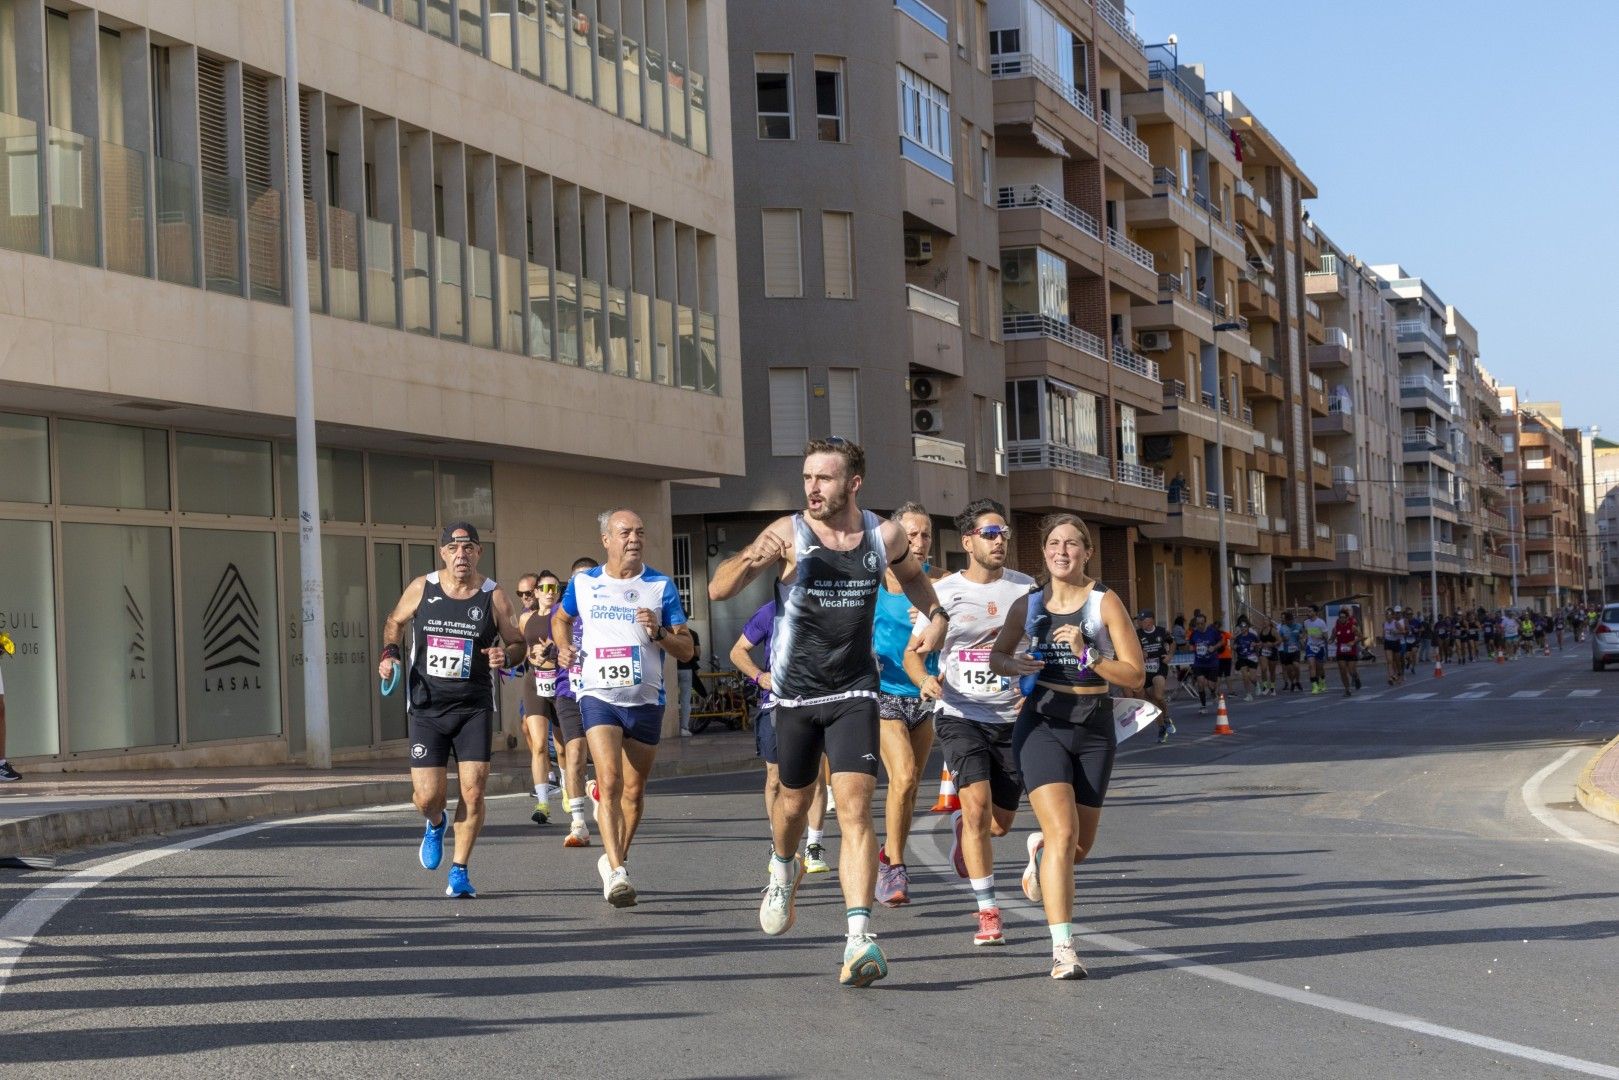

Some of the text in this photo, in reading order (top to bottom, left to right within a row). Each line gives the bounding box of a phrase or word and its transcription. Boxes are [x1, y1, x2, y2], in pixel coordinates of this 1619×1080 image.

[814, 578, 877, 588] CLUB ATLETISMO
[807, 588, 835, 597] PUERTO
[609, 605, 636, 613] Atletism
[590, 609, 635, 623] Torreviej
[443, 621, 476, 630] ATLETISMO
[445, 627, 480, 637] TORREVIEJA
[429, 654, 460, 670] 217
[598, 665, 630, 680] 139
[963, 670, 998, 684] 152
[205, 676, 261, 692] LASAL
